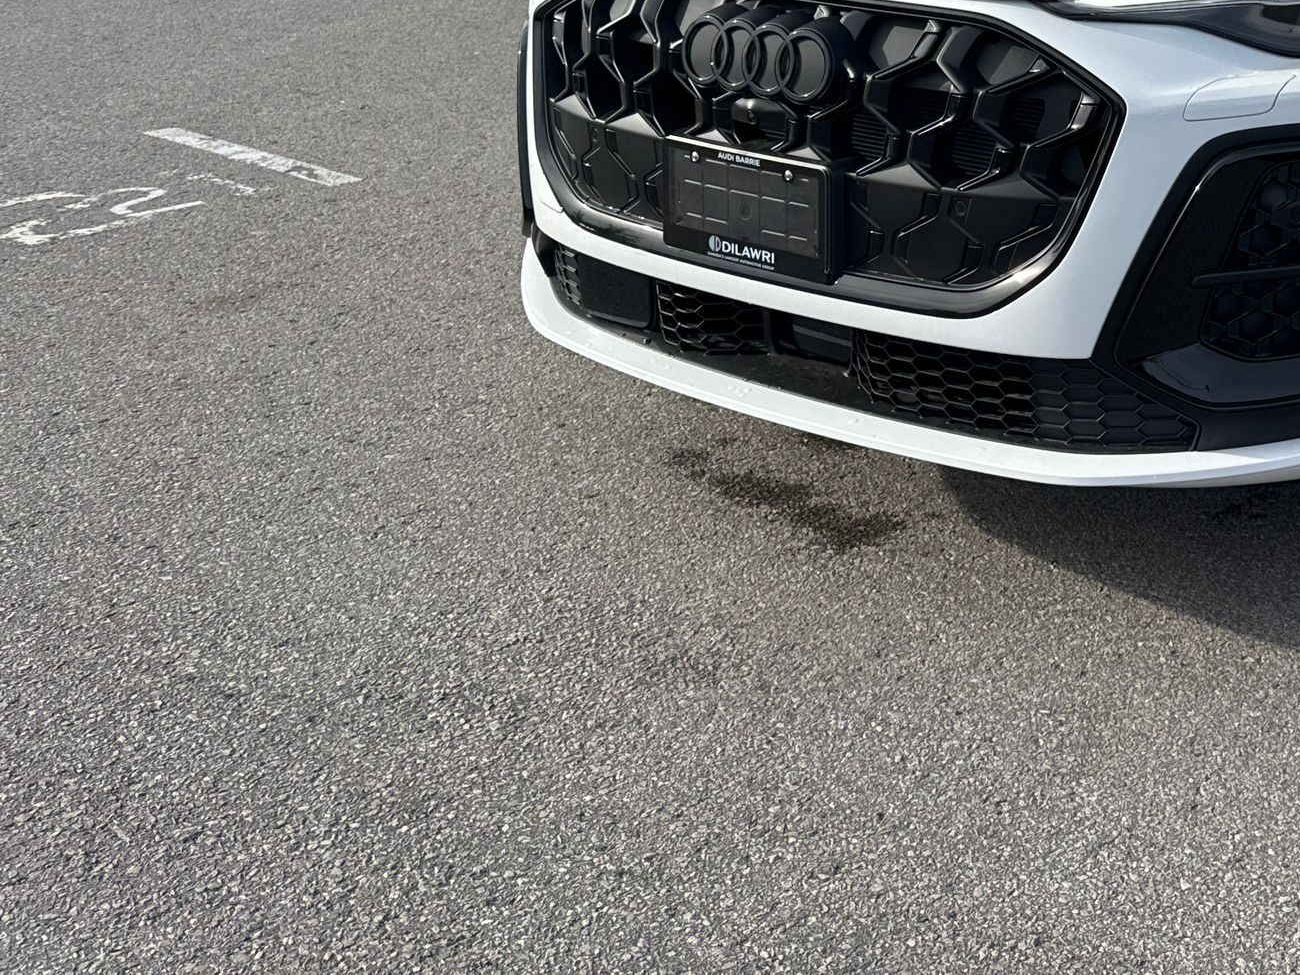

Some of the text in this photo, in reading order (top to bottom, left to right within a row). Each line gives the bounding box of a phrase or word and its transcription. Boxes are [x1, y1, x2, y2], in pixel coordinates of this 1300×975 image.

[717, 151, 761, 167] AUDI BARRIE
[721, 240, 775, 265] DILAWRI
